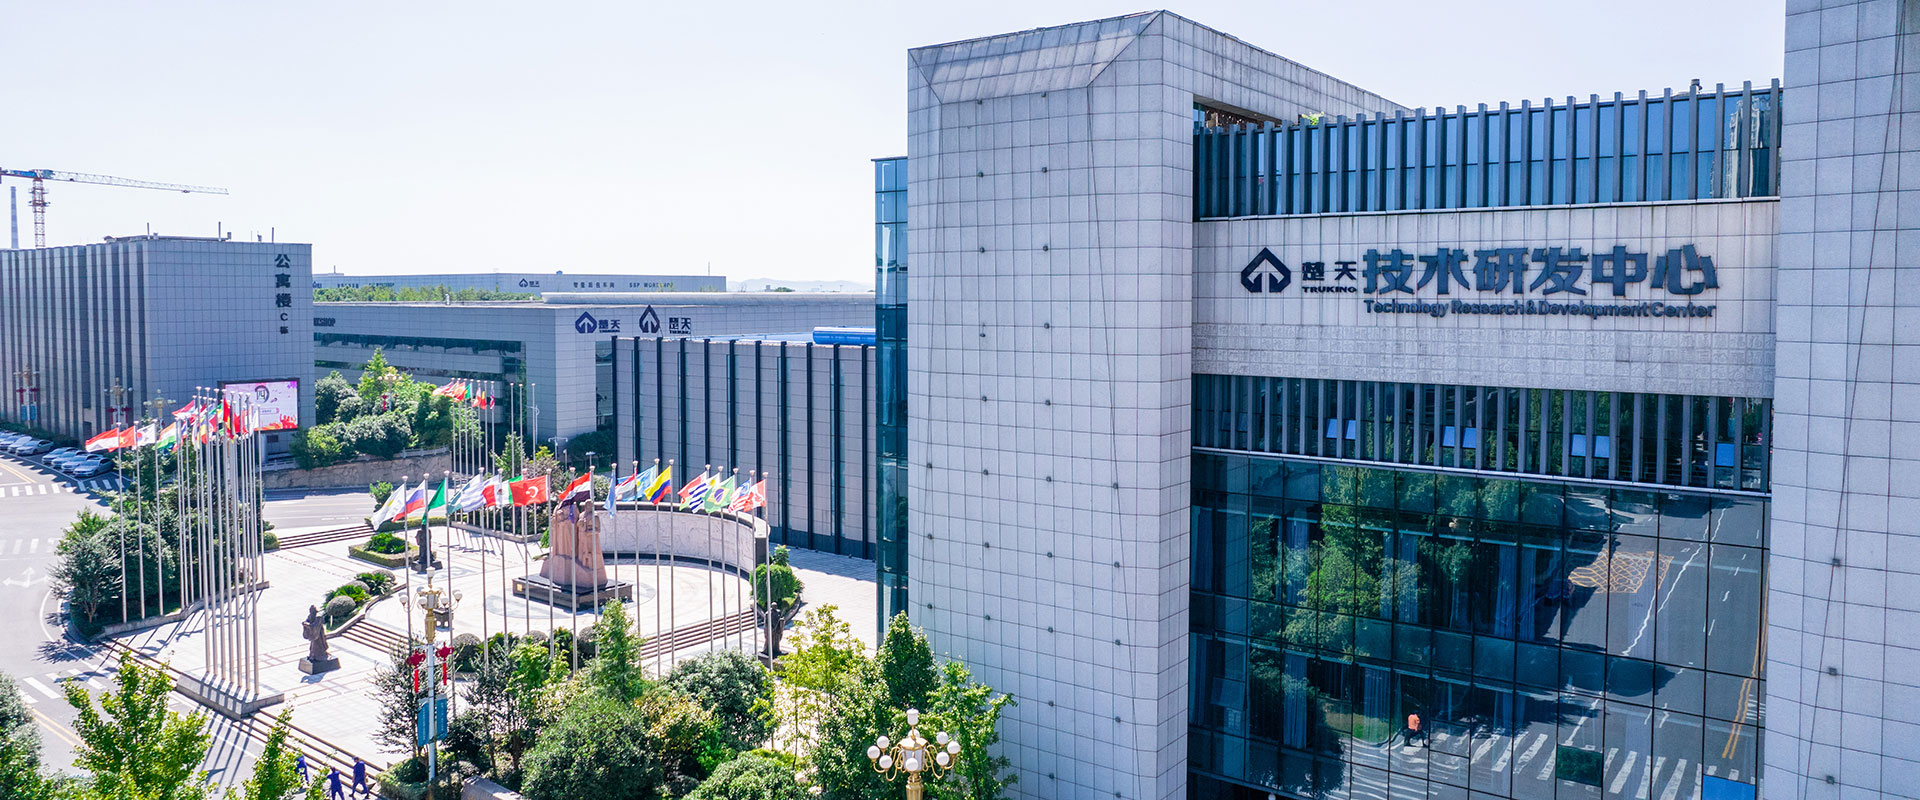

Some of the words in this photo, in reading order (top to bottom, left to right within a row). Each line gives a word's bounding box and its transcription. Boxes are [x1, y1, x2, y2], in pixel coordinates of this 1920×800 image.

[1302, 261, 1356, 281] 楚天
[1363, 244, 1719, 297] 技术研发中心
[1364, 299, 1449, 318] Technology
[1651, 301, 1717, 318] Center
